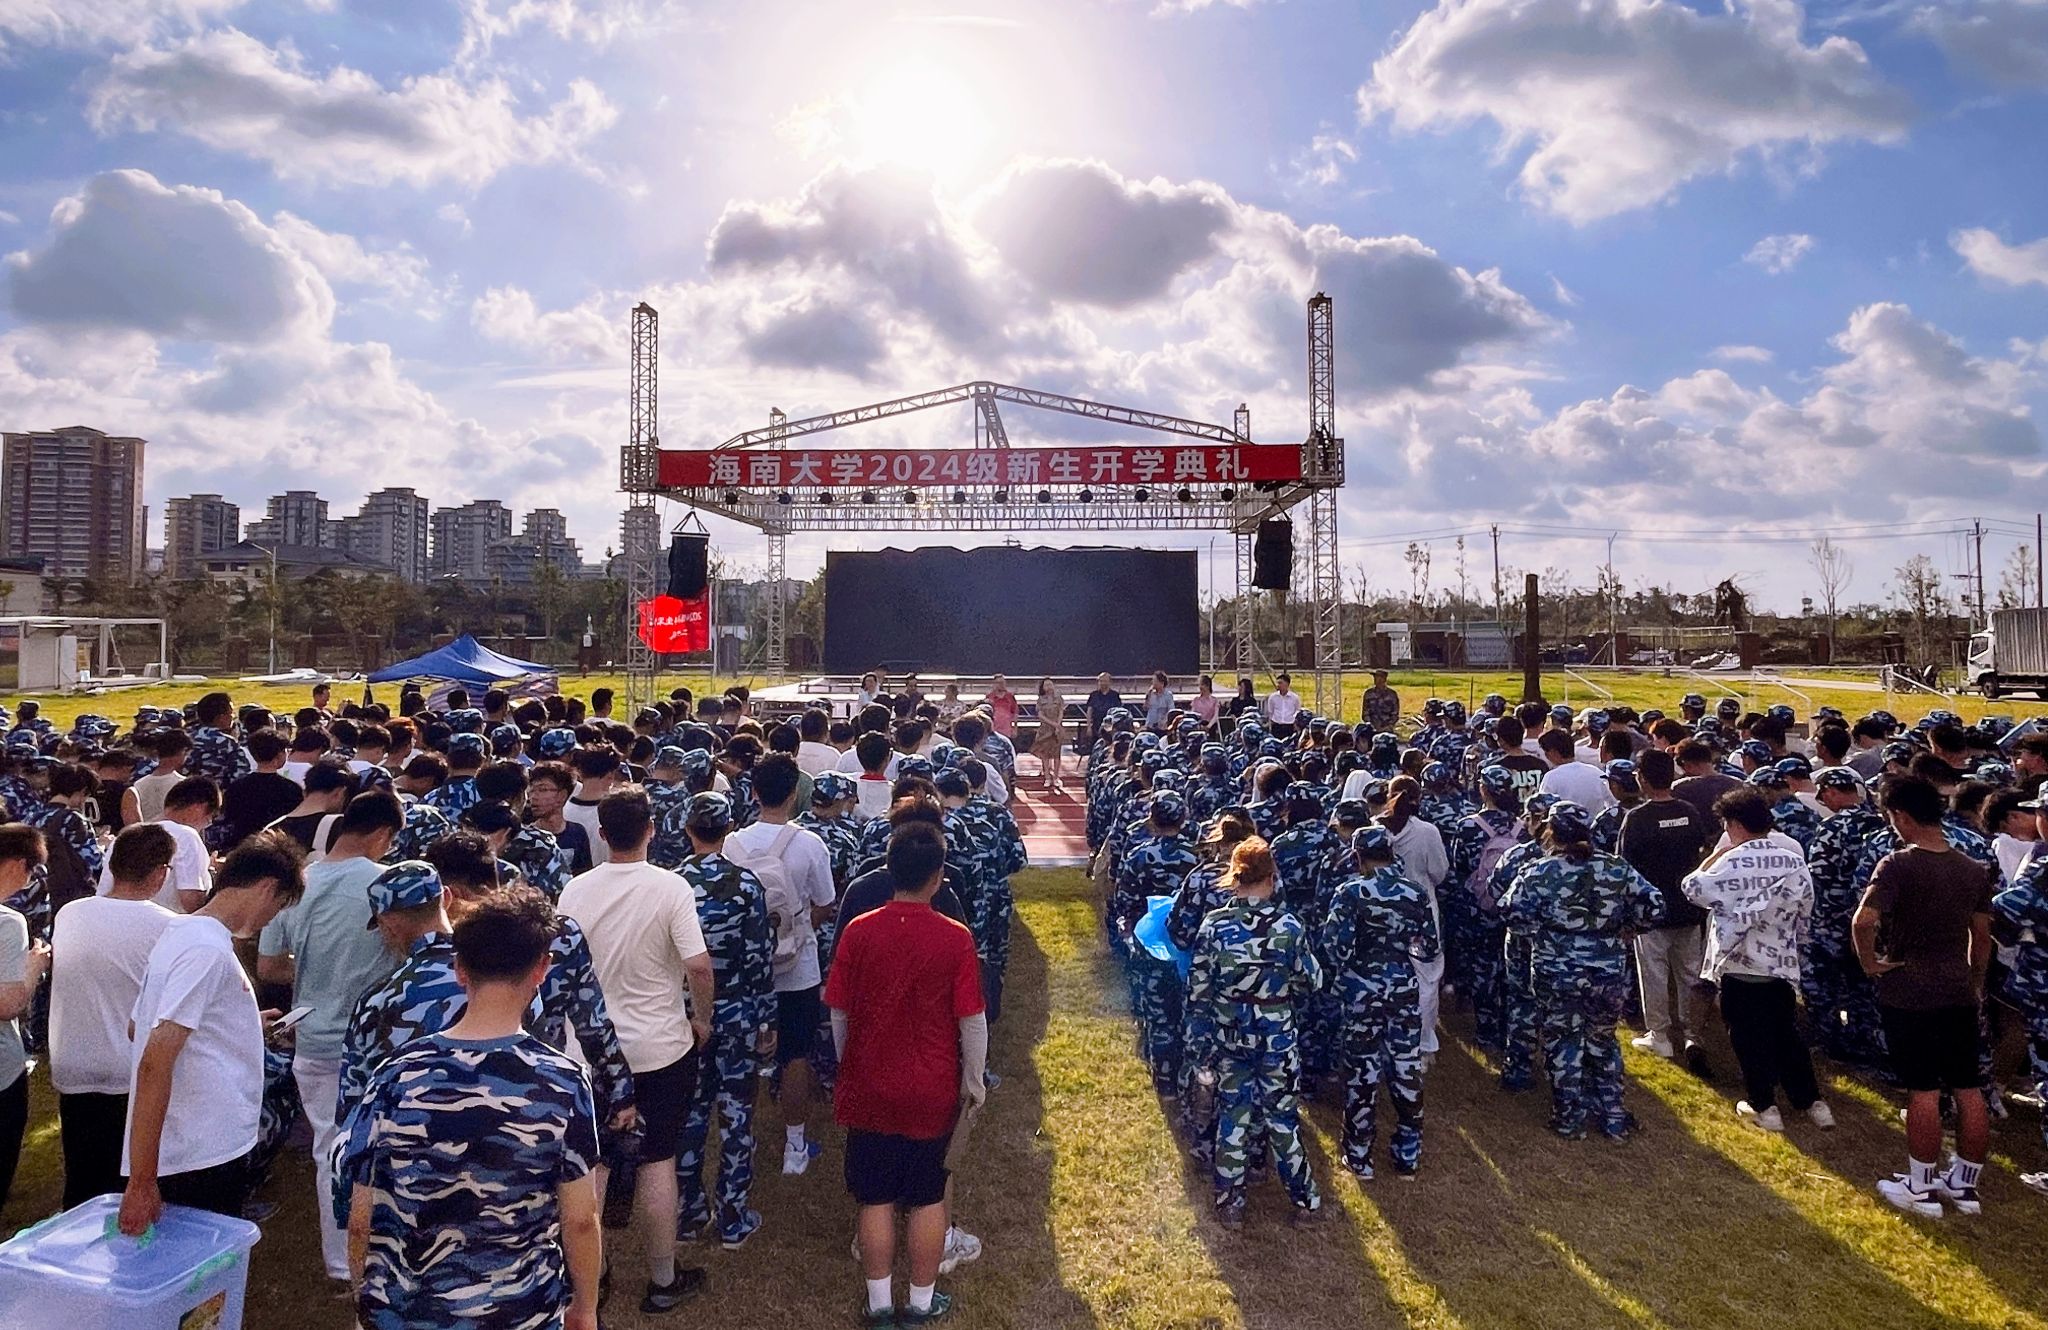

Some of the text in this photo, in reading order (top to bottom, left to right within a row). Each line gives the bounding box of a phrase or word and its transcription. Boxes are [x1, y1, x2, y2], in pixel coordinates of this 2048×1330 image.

[708, 449, 1250, 485] 海南大学2024级新生开学典礼
[1511, 769, 1542, 789] JUST
